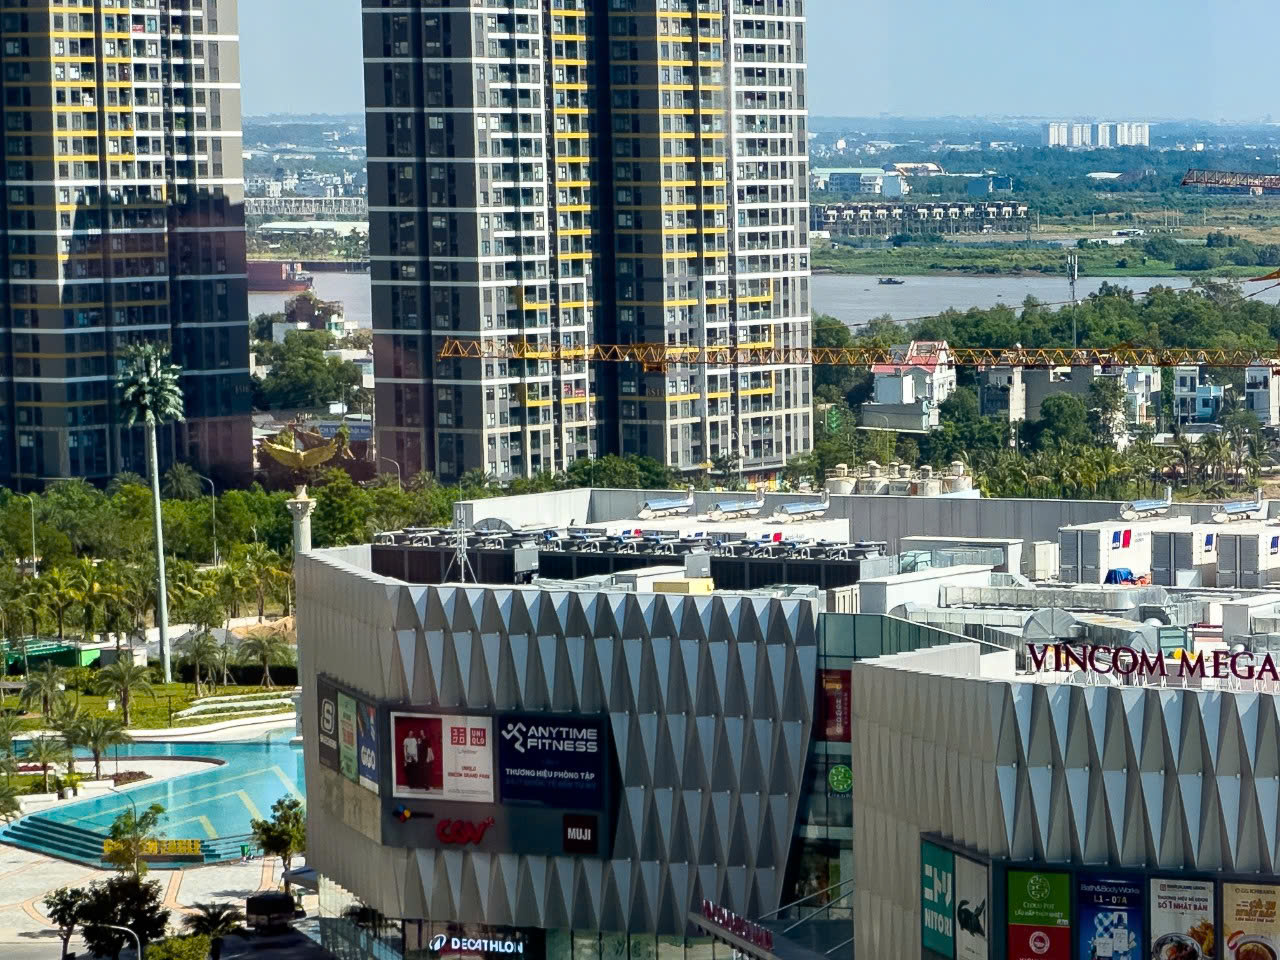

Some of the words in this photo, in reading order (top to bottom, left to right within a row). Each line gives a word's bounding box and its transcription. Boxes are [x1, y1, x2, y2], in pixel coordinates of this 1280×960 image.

[1026, 643, 1168, 677] VINCOM
[527, 726, 598, 740] ANYTIME
[471, 737, 485, 745] QLO
[527, 738, 598, 752] FITNESS
[567, 827, 591, 840] MUJI
[924, 907, 952, 937] NITORI
[451, 938, 524, 953] DECATHLON
